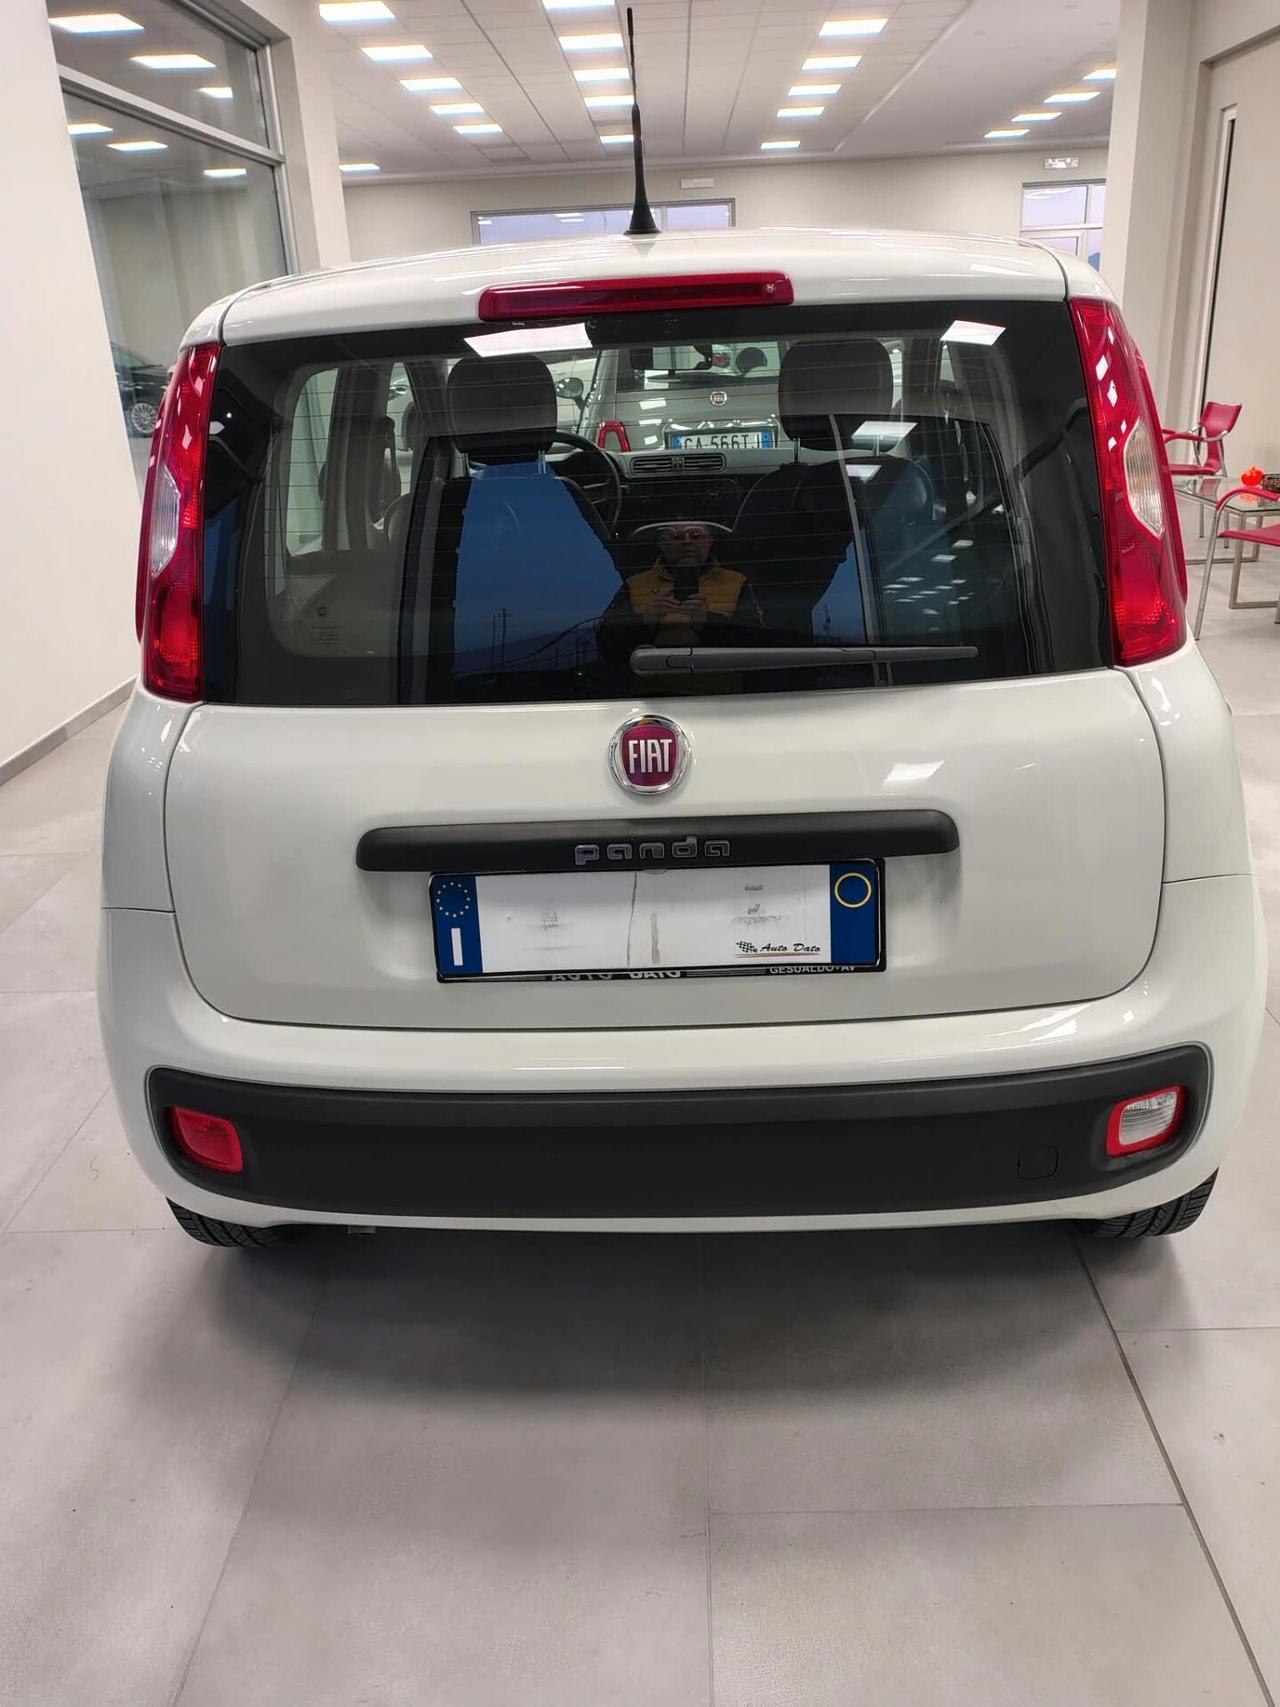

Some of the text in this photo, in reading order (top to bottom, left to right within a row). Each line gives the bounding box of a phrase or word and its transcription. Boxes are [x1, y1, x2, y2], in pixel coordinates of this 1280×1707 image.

[628, 738, 673, 774] FIAT
[575, 835, 730, 865] panda
[760, 942, 821, 952] Auto Dato
